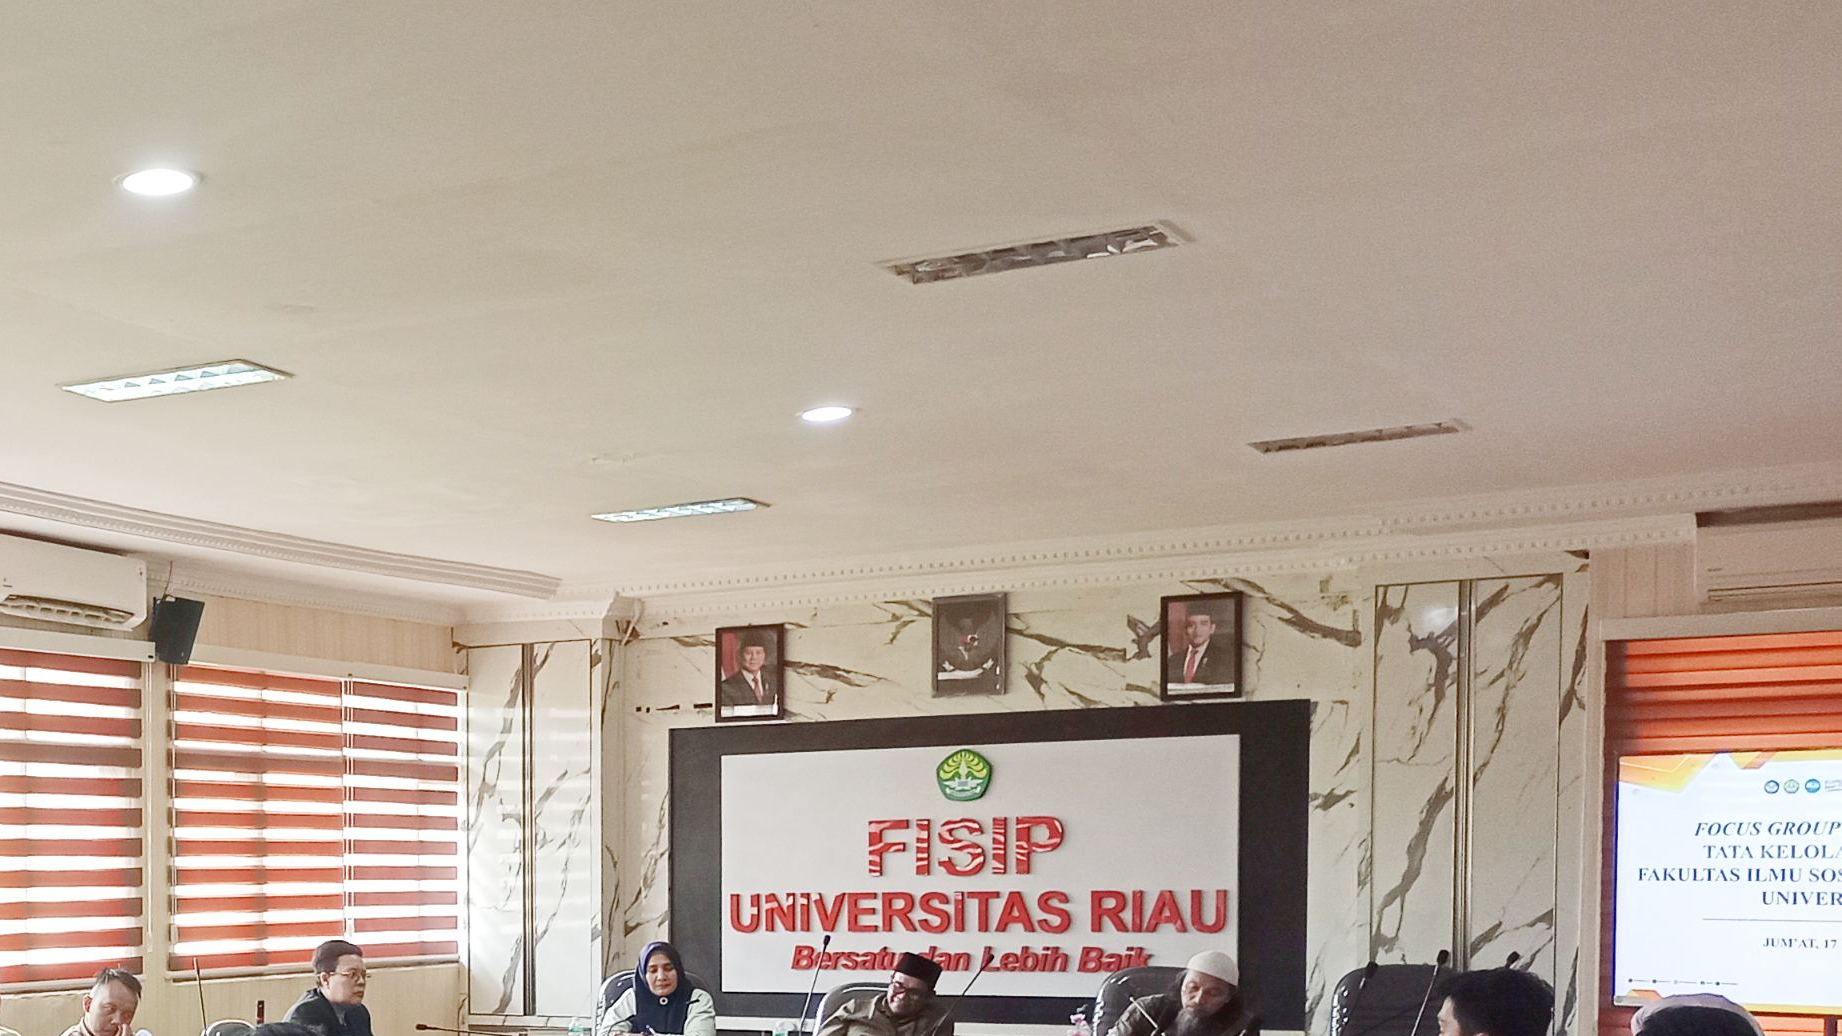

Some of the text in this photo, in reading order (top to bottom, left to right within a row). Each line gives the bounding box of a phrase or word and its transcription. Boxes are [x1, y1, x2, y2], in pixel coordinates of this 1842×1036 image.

[1694, 821, 1842, 837] FOCUS GROUP
[868, 816, 1064, 877] FISIP
[1702, 844, 1754, 860] TATA
[1638, 867, 1741, 882] FAKULTAS
[1747, 867, 1803, 882] ILMU
[1761, 890, 1842, 906] UNIVER
[729, 889, 1228, 935] UNIVERSITAS RIAU
[1824, 938, 1838, 950] 17
[980, 945, 1068, 972] Lebih
[1077, 946, 1154, 973] Baik
